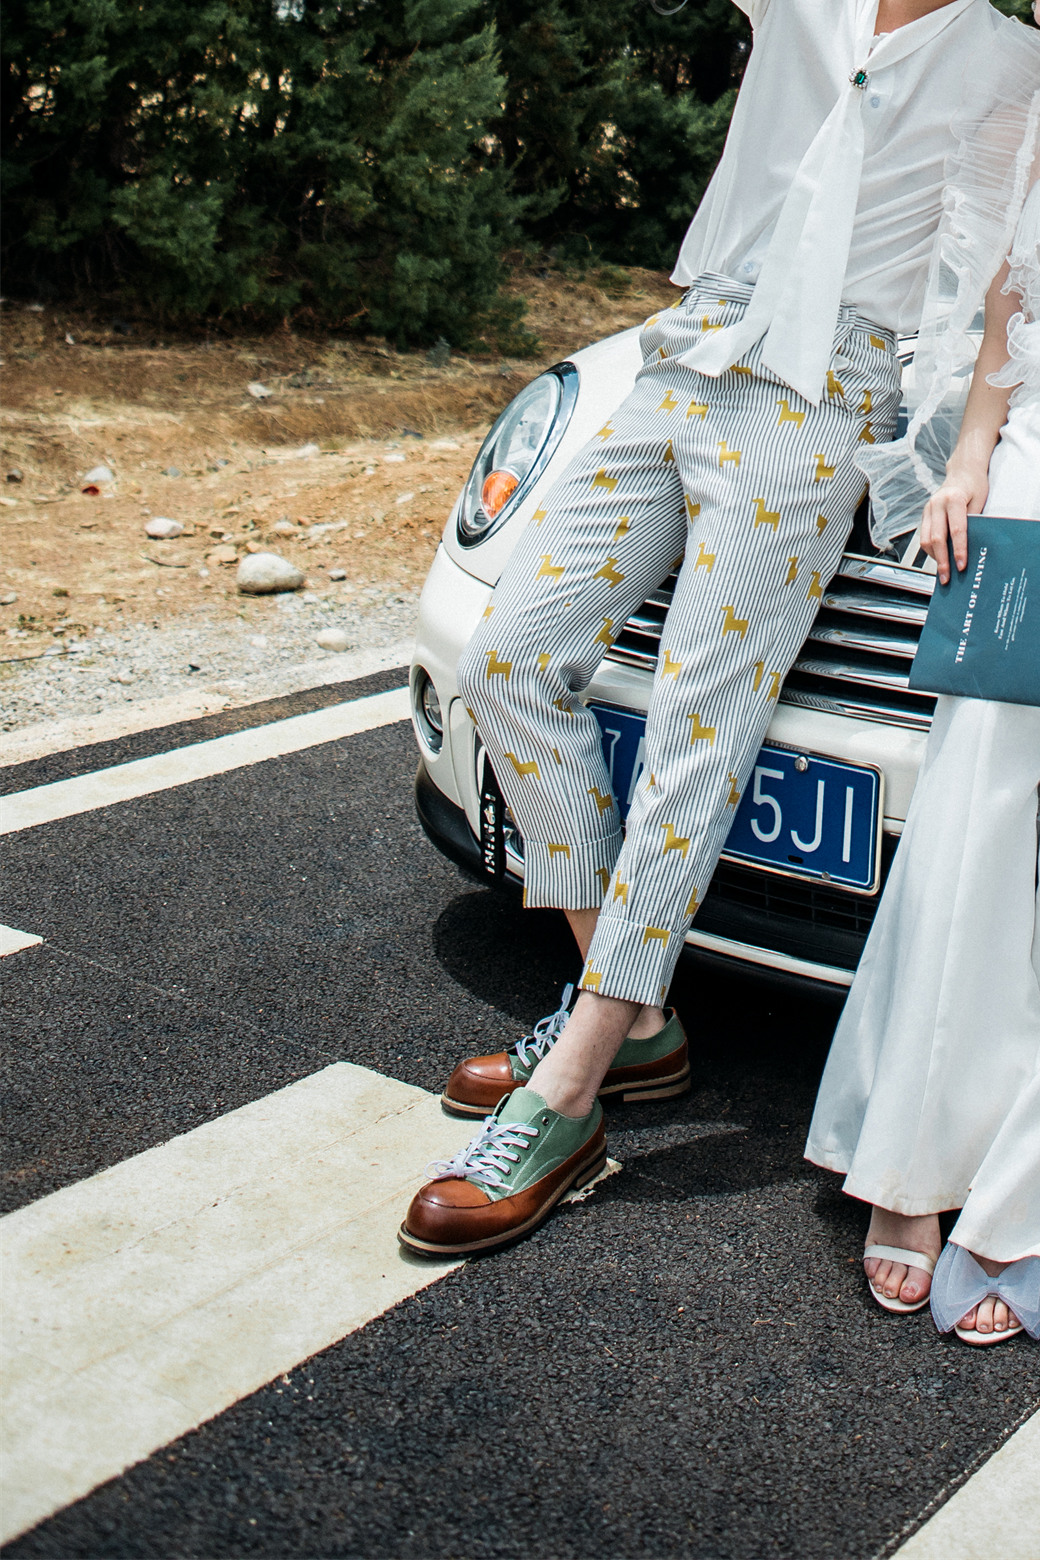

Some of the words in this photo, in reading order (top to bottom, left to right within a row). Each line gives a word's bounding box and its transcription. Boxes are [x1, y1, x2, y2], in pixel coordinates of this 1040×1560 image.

[955, 638, 967, 664] THE
[962, 611, 974, 636] ART
[969, 591, 977, 608] OF
[973, 547, 987, 589] LIVING
